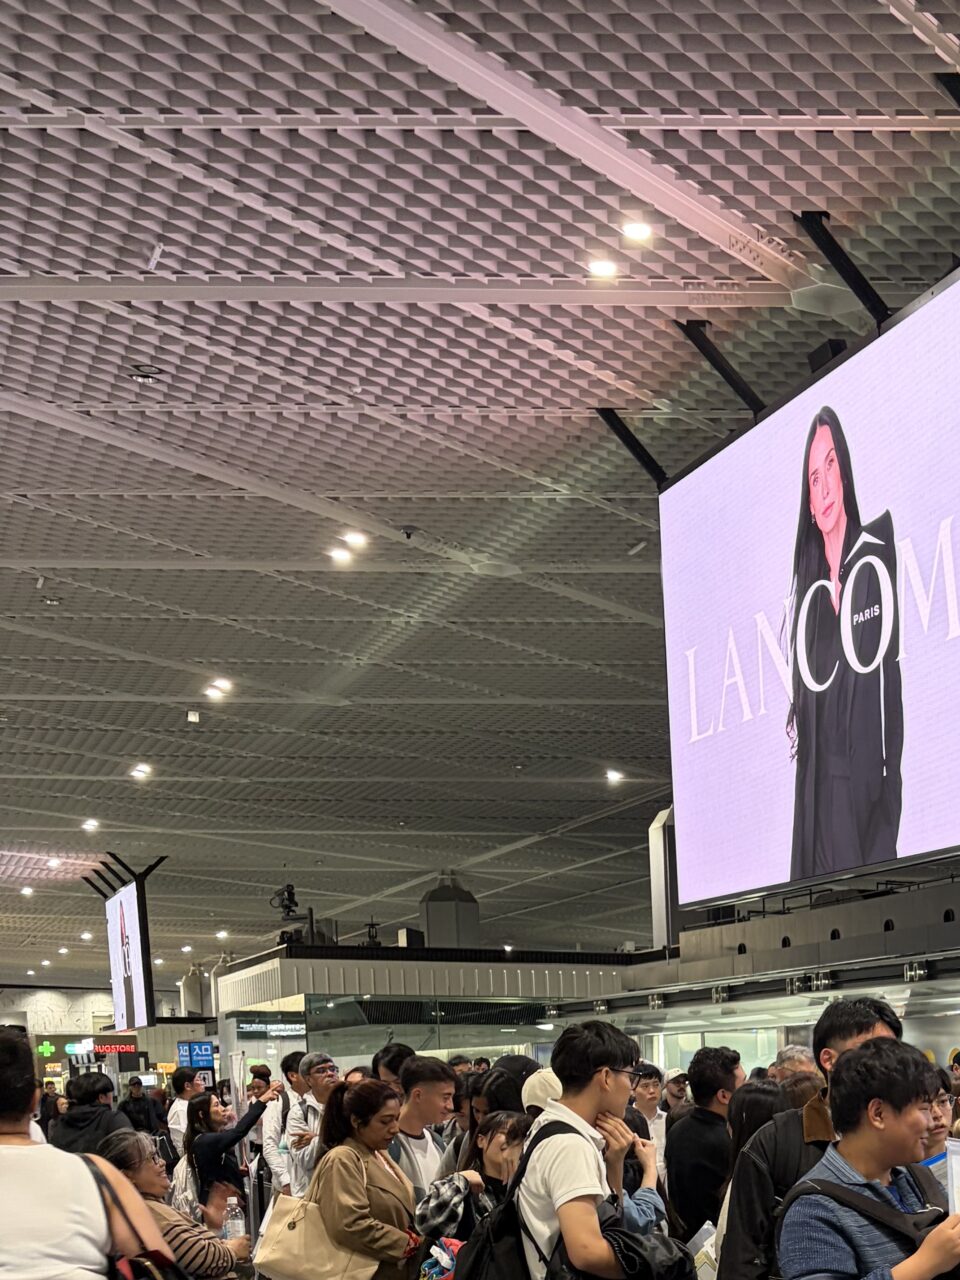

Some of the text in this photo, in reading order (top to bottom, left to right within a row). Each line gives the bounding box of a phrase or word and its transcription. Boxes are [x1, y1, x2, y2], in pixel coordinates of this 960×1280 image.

[853, 604, 880, 626] PARIS
[93, 1044, 135, 1053] RUGSTORE
[193, 1045, 212, 1055] 入口
